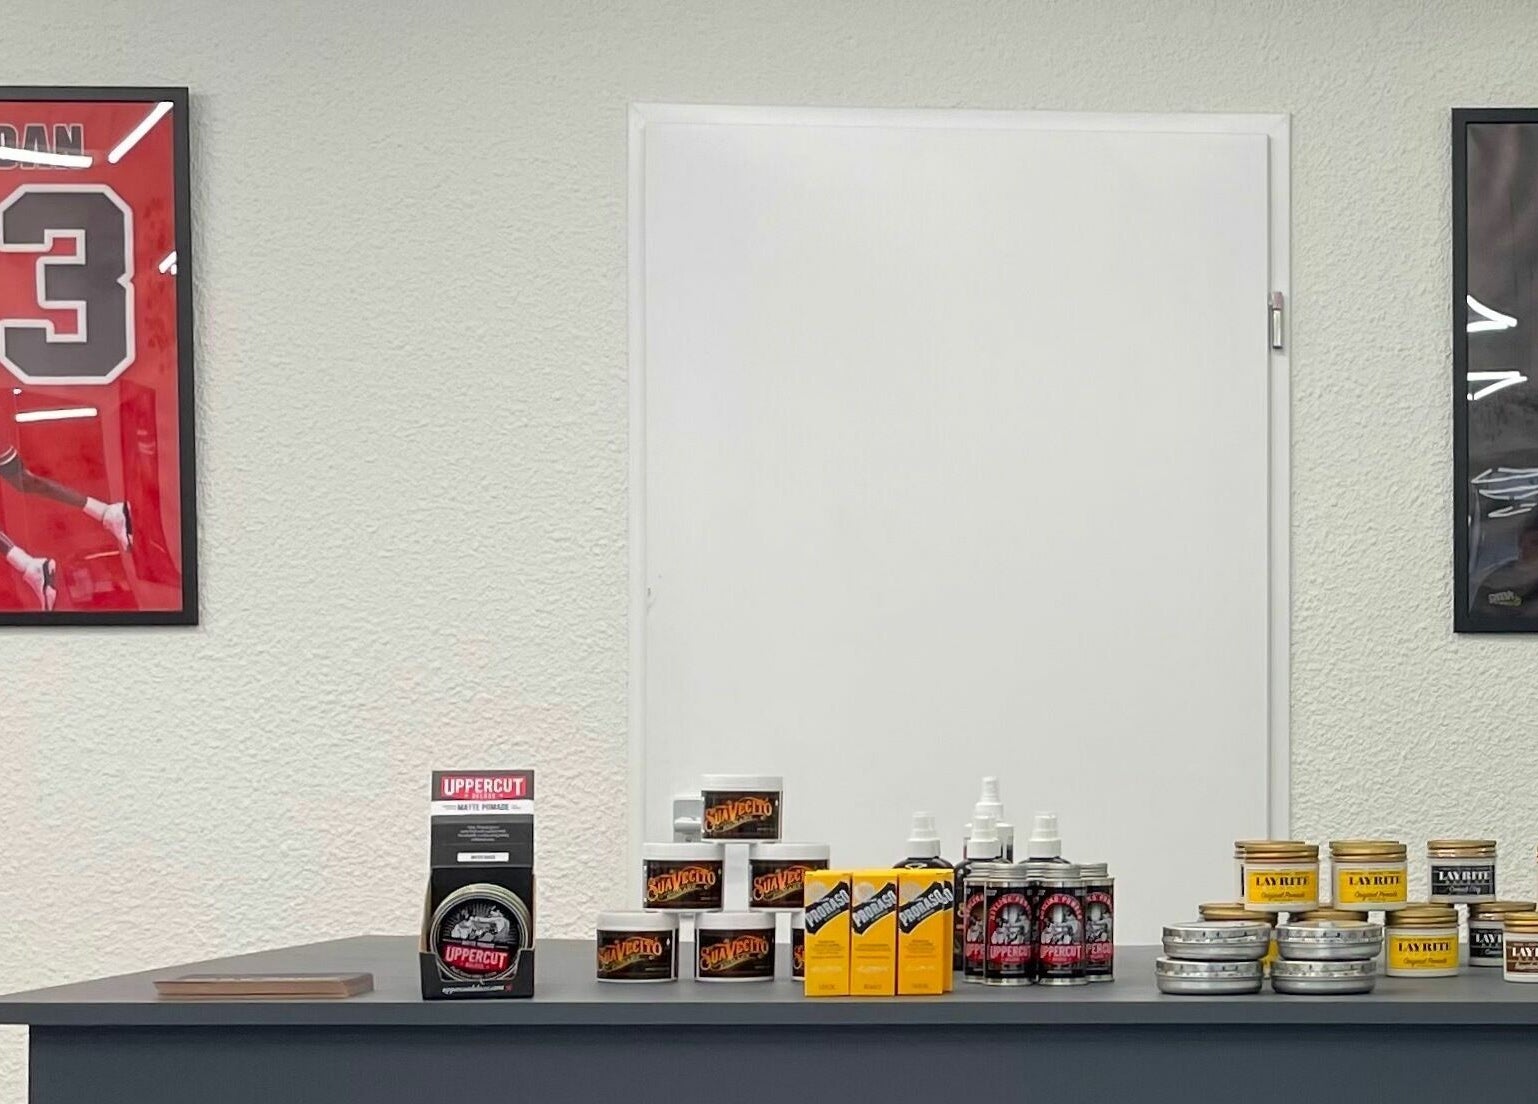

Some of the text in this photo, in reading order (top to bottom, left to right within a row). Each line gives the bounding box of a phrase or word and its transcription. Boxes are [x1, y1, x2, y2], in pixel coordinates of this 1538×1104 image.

[443, 778, 524, 797] UPPERCUT
[753, 865, 805, 901] SUAVEC
[1256, 876, 1310, 887] LAYRITE
[1439, 871, 1490, 881] LAYRITE
[805, 889, 849, 928] PRORASO
[852, 890, 897, 928] PRORASO
[900, 888, 943, 927] PRORASO
[445, 946, 508, 969] UPPERCUT
[1398, 942, 1449, 952] LAYRITE
